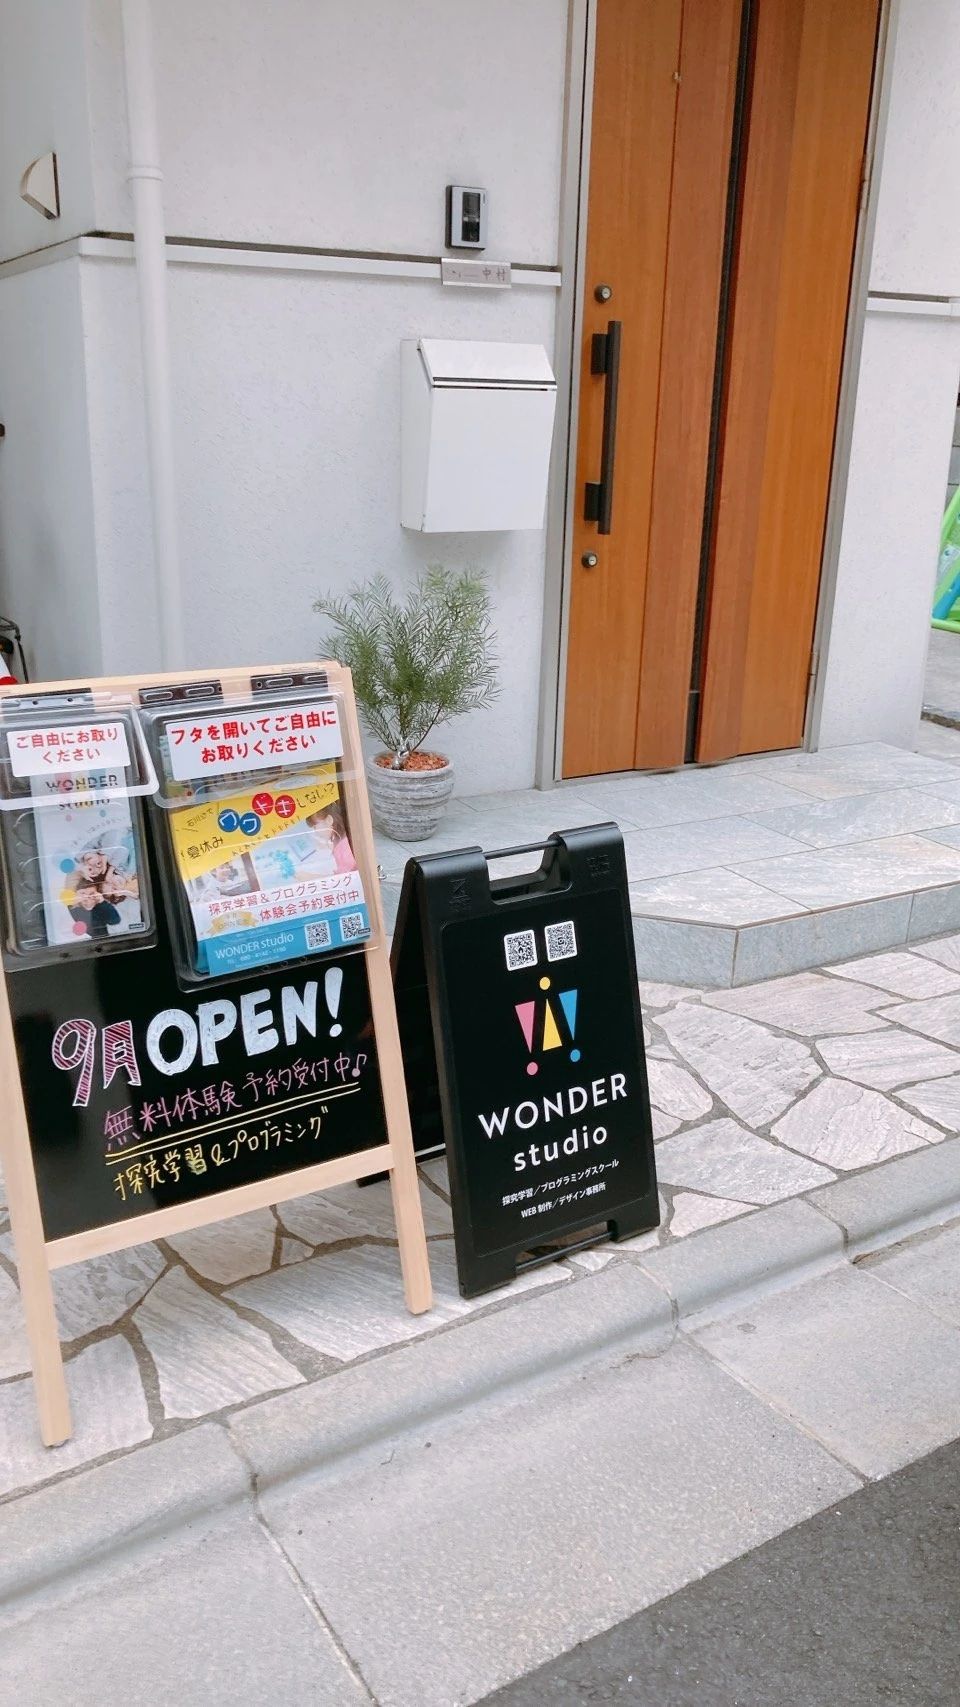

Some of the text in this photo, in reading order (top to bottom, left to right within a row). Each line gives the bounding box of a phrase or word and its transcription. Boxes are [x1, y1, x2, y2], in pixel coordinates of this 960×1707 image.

[16, 727, 118, 749] ご自由にお取り
[171, 710, 336, 745] フタを開いてご自由に
[43, 748, 100, 764] ください
[201, 734, 316, 764] お取りください
[45, 774, 118, 793] WONDER
[259, 890, 360, 922] 体験会予約受付中
[215, 941, 260, 960] WONDER
[260, 931, 294, 949] studio
[146, 966, 344, 1076] OPEN!
[478, 1073, 628, 1140] WONDER
[513, 1125, 608, 1172] studio
[520, 1204, 537, 1219] WEB
